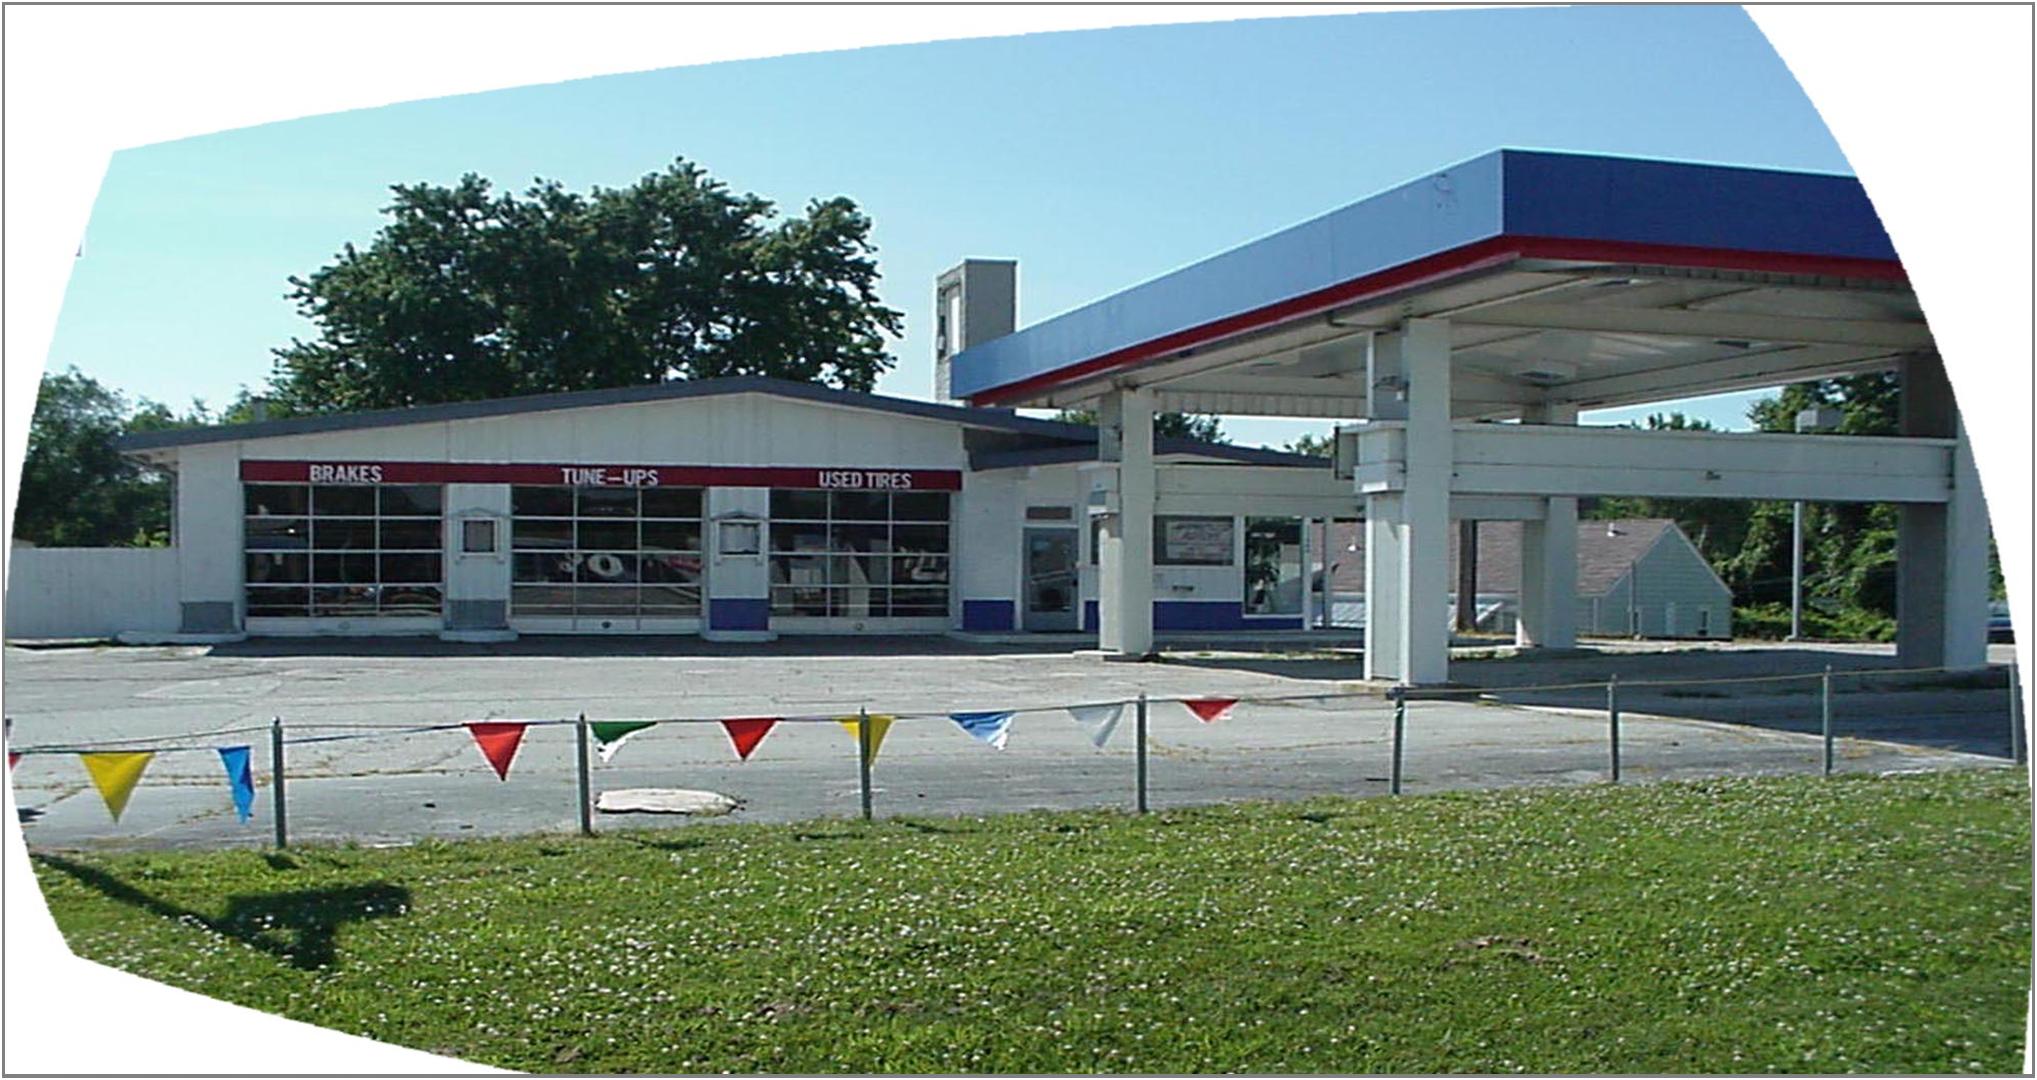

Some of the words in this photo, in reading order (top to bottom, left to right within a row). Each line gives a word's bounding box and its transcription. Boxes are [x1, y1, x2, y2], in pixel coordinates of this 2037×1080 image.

[309, 464, 383, 483] BRAKES
[561, 468, 659, 486] TUNE-UPS
[819, 471, 863, 488] USED
[864, 472, 912, 489] TIRES
